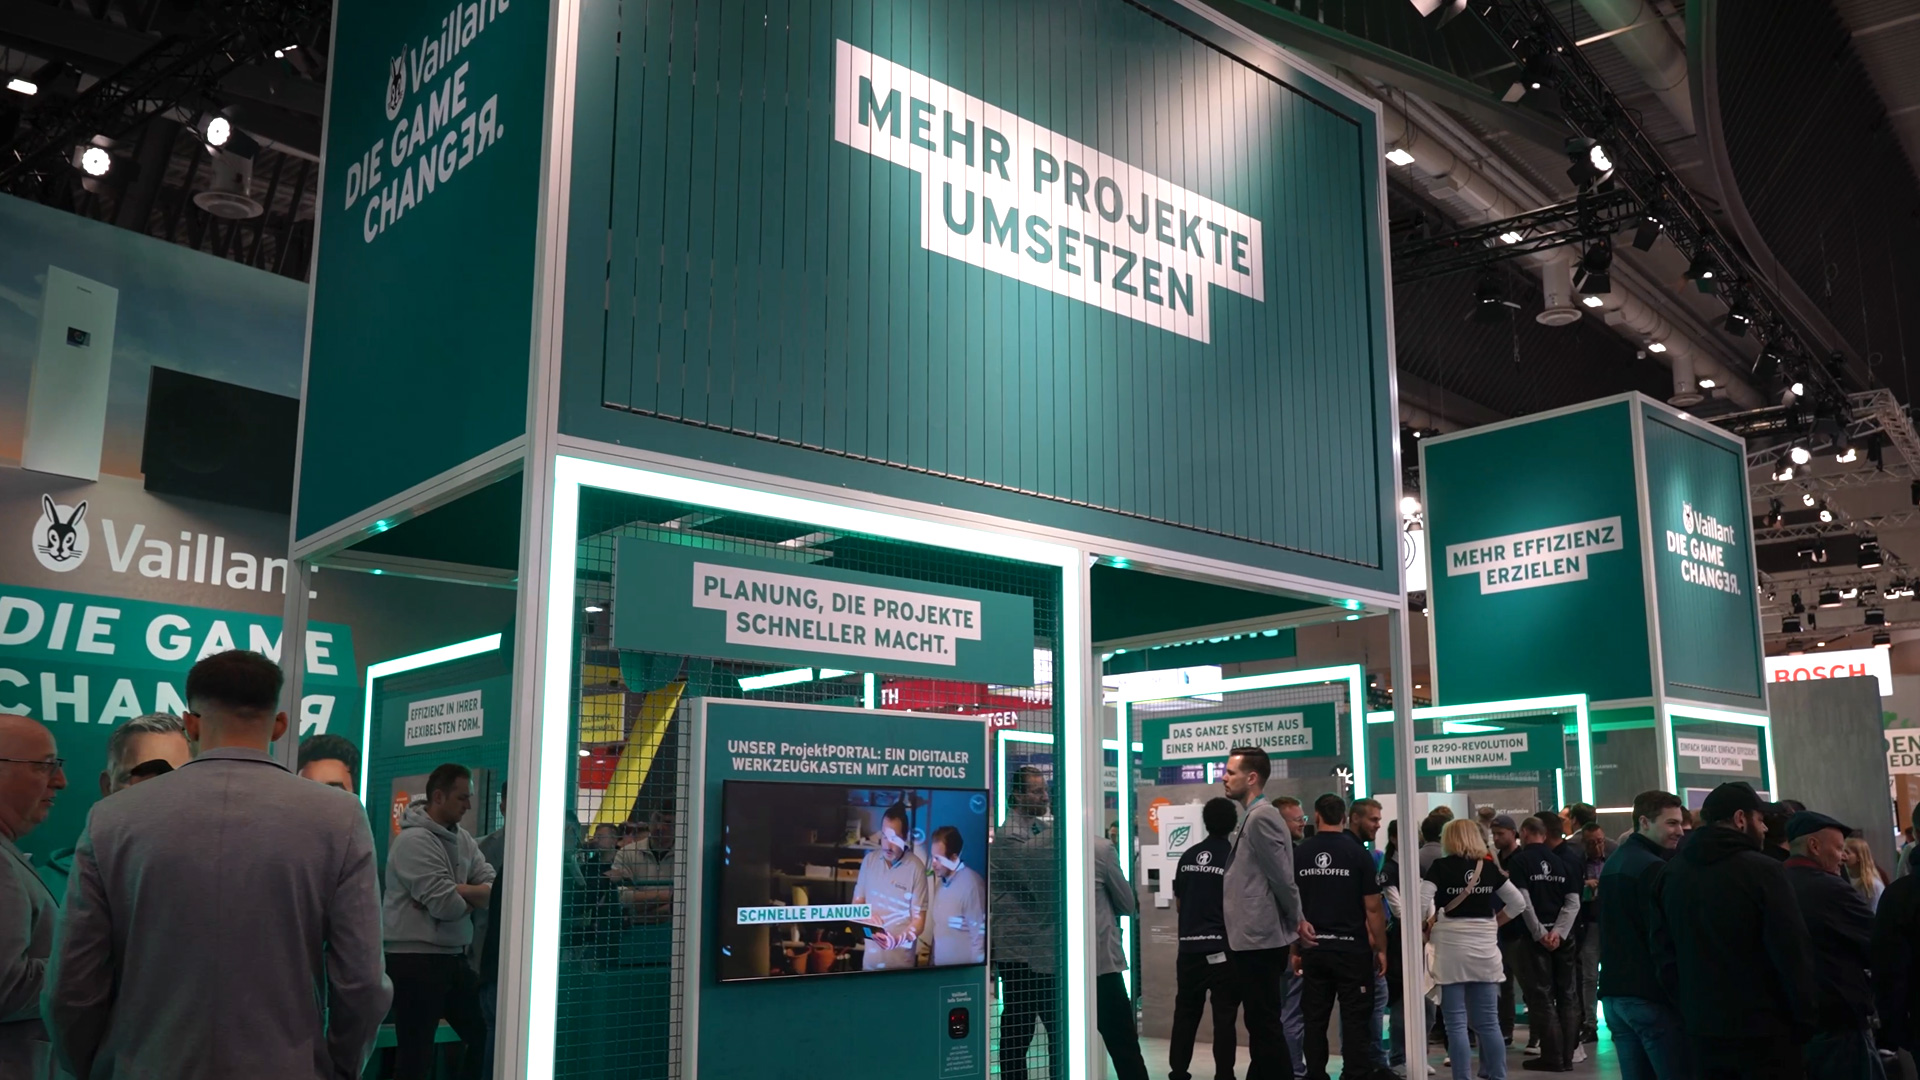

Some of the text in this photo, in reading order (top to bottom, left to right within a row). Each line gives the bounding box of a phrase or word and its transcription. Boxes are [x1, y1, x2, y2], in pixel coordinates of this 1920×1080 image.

[345, 61, 469, 210] DIE GAME
[858, 75, 1250, 276] MEHR PROJEKTE
[943, 181, 1194, 316] UMSETZEN
[1693, 511, 1735, 545] Vaillant
[101, 519, 319, 599] Vaillan
[1453, 526, 1615, 568] MEHR EFFIZIENZ
[1666, 530, 1724, 567] DIE GAME
[1487, 556, 1580, 585] ERZIELEN
[704, 575, 973, 629] PLANUNG, DIE PROJEKTE
[0, 596, 120, 655] DIE
[736, 611, 949, 655] SCHNELLER MACHT.
[411, 698, 479, 721] EFFIZIENZ IN IHRER
[407, 717, 481, 739] FLEXIBELSTEN FORM.
[1173, 719, 1300, 739] DAS GANZE SYSTEM AUS
[728, 740, 969, 764] UNSER ProjektPORTAL: EIN DIGITALER
[1166, 734, 1309, 754] EINER HAND. AUS UNSERER.
[1415, 738, 1524, 754] DIE R290-REVOLUTION
[1680, 743, 1757, 756] EINFACH SMART. EINFACH EFFIZIENT.
[732, 757, 966, 779] WERKZEUGKASTEN MIT ACHT TOOLS
[1431, 753, 1507, 766] IM INNENRAUM.
[1701, 756, 1741, 767] EINFACH OPTIMAL.
[1181, 864, 1225, 875] CHRISTOFFER
[739, 906, 870, 921] SCHNELLE PLANUNG
